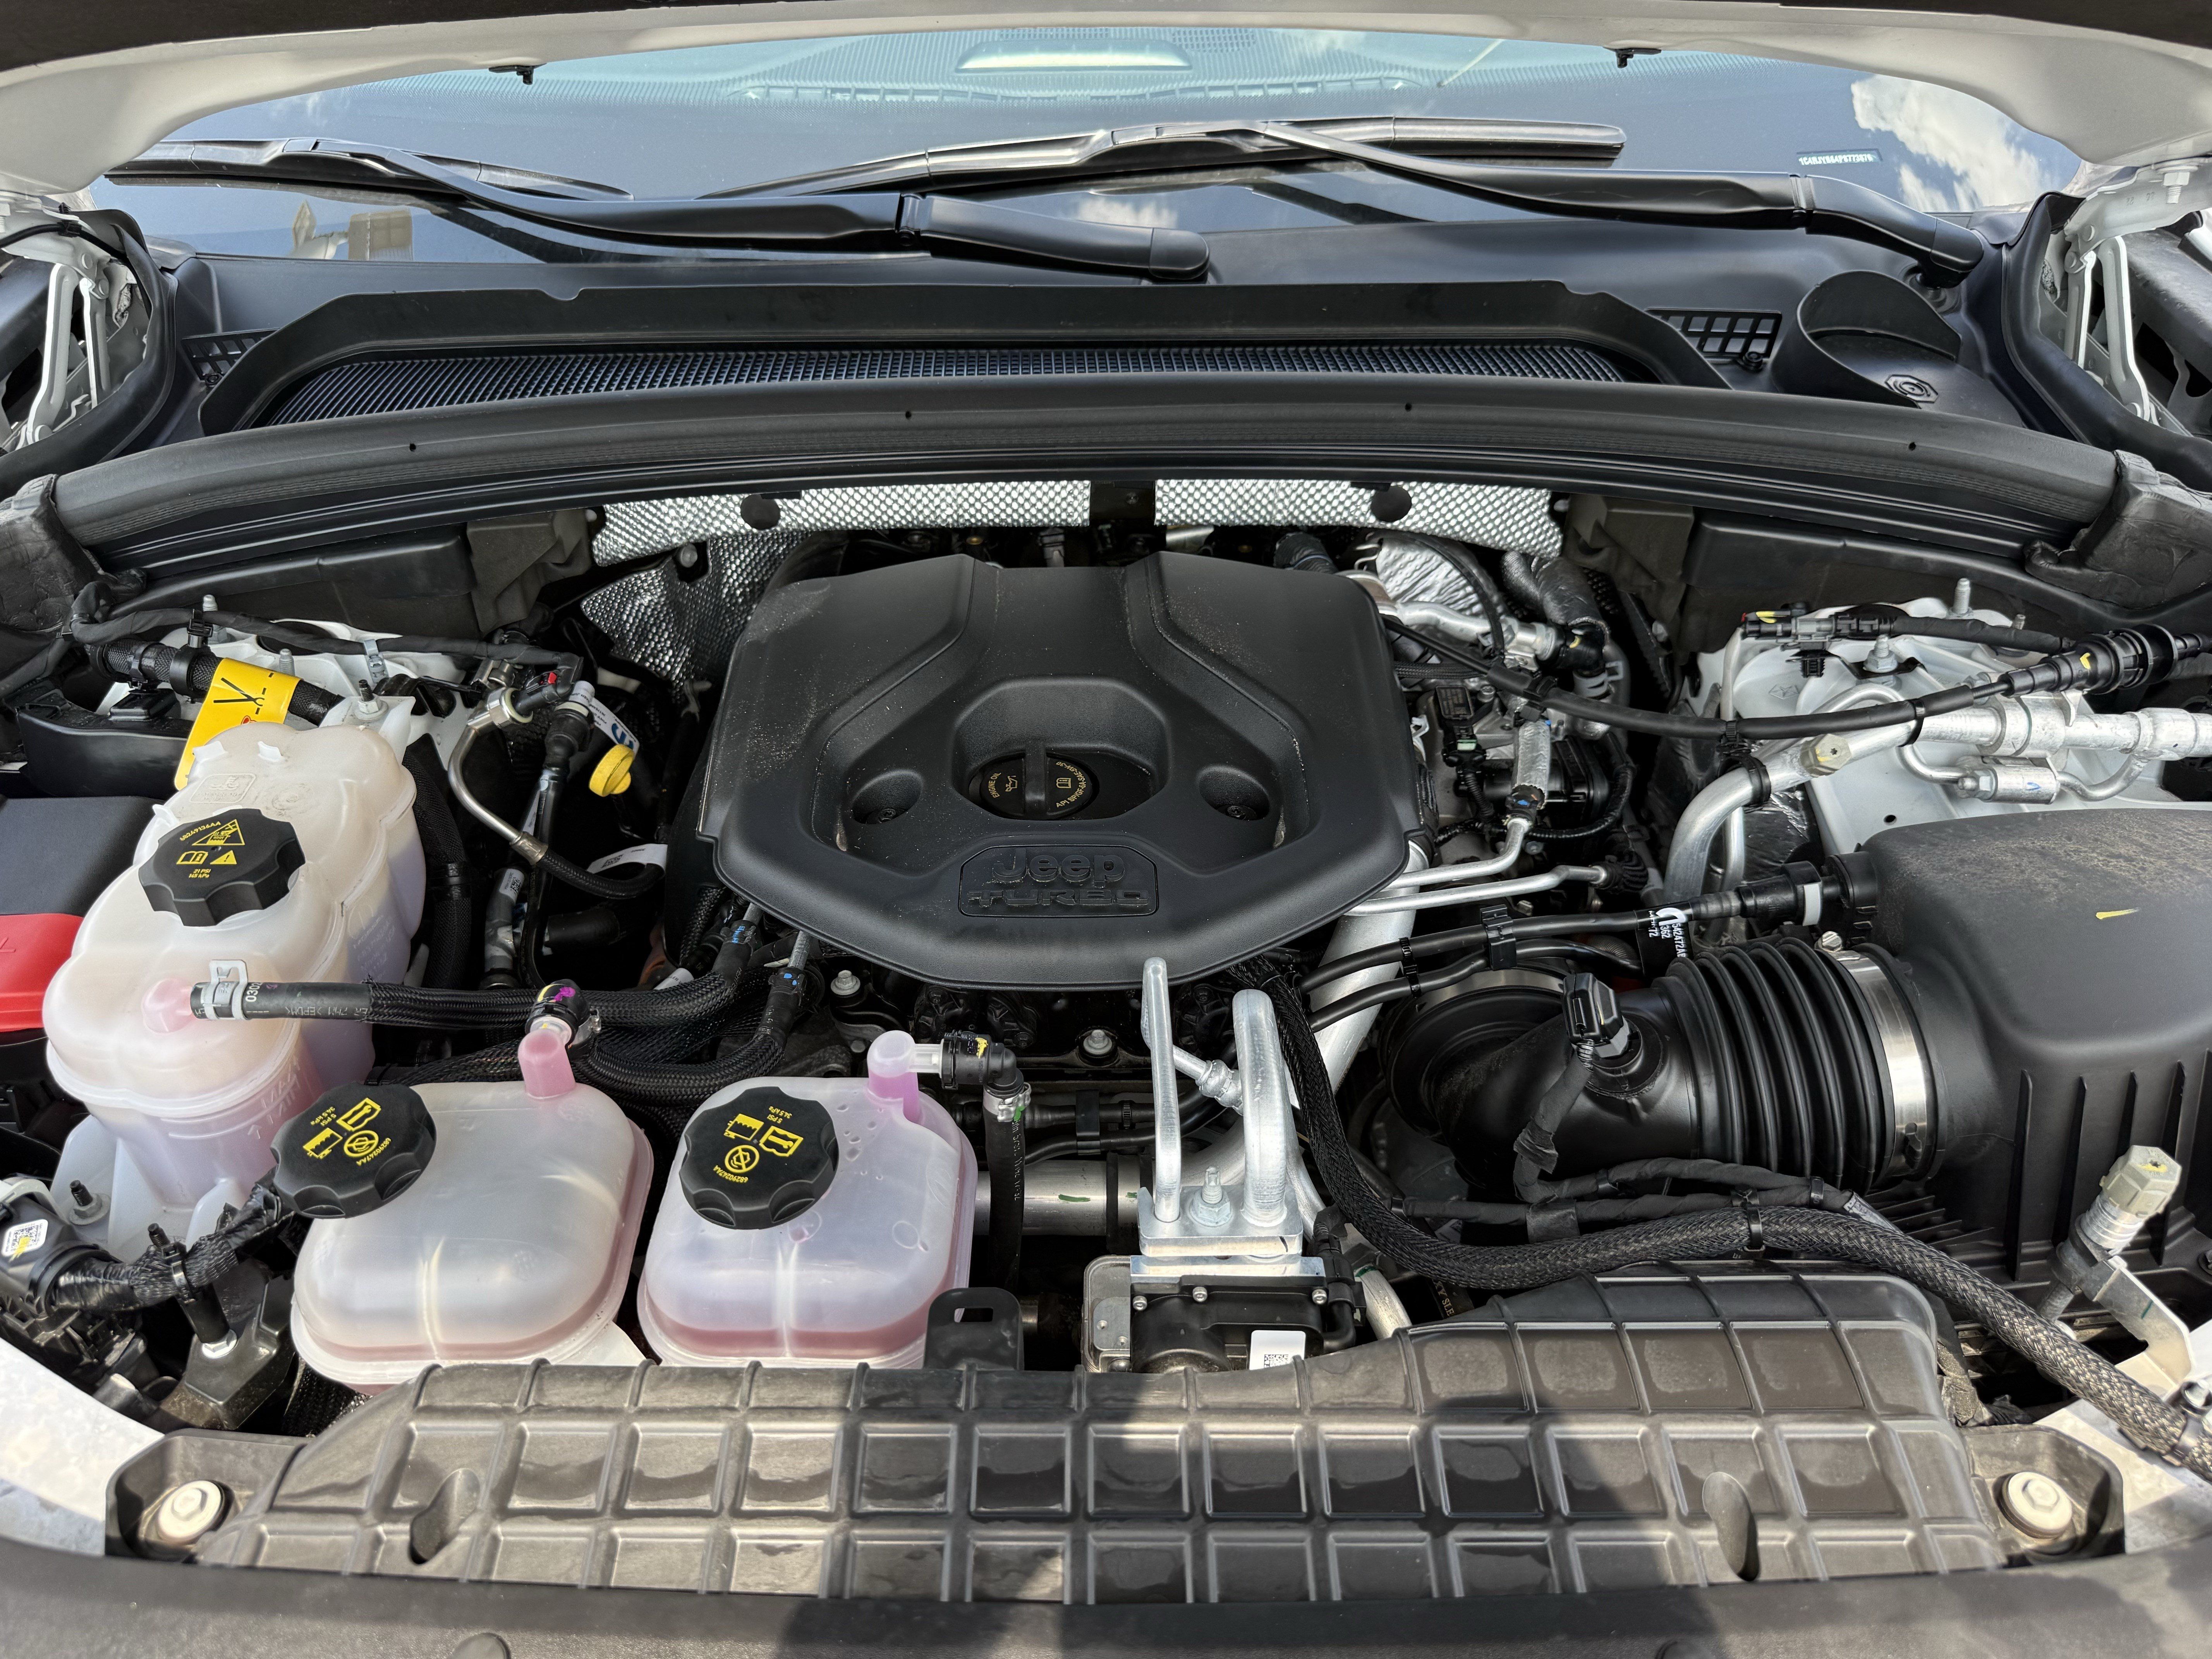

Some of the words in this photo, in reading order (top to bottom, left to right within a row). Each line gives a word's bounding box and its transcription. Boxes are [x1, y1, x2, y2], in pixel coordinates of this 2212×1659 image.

[990, 772, 1001, 781] OIL
[987, 780, 1000, 798] ENGINE
[1056, 800, 1070, 808] API
[993, 848, 1125, 888] Jeep
[968, 889, 1149, 907] TURBO
[1660, 925, 1671, 939] 362
[320, 1116, 333, 1127] PSI
[767, 1114, 777, 1123] PSI
